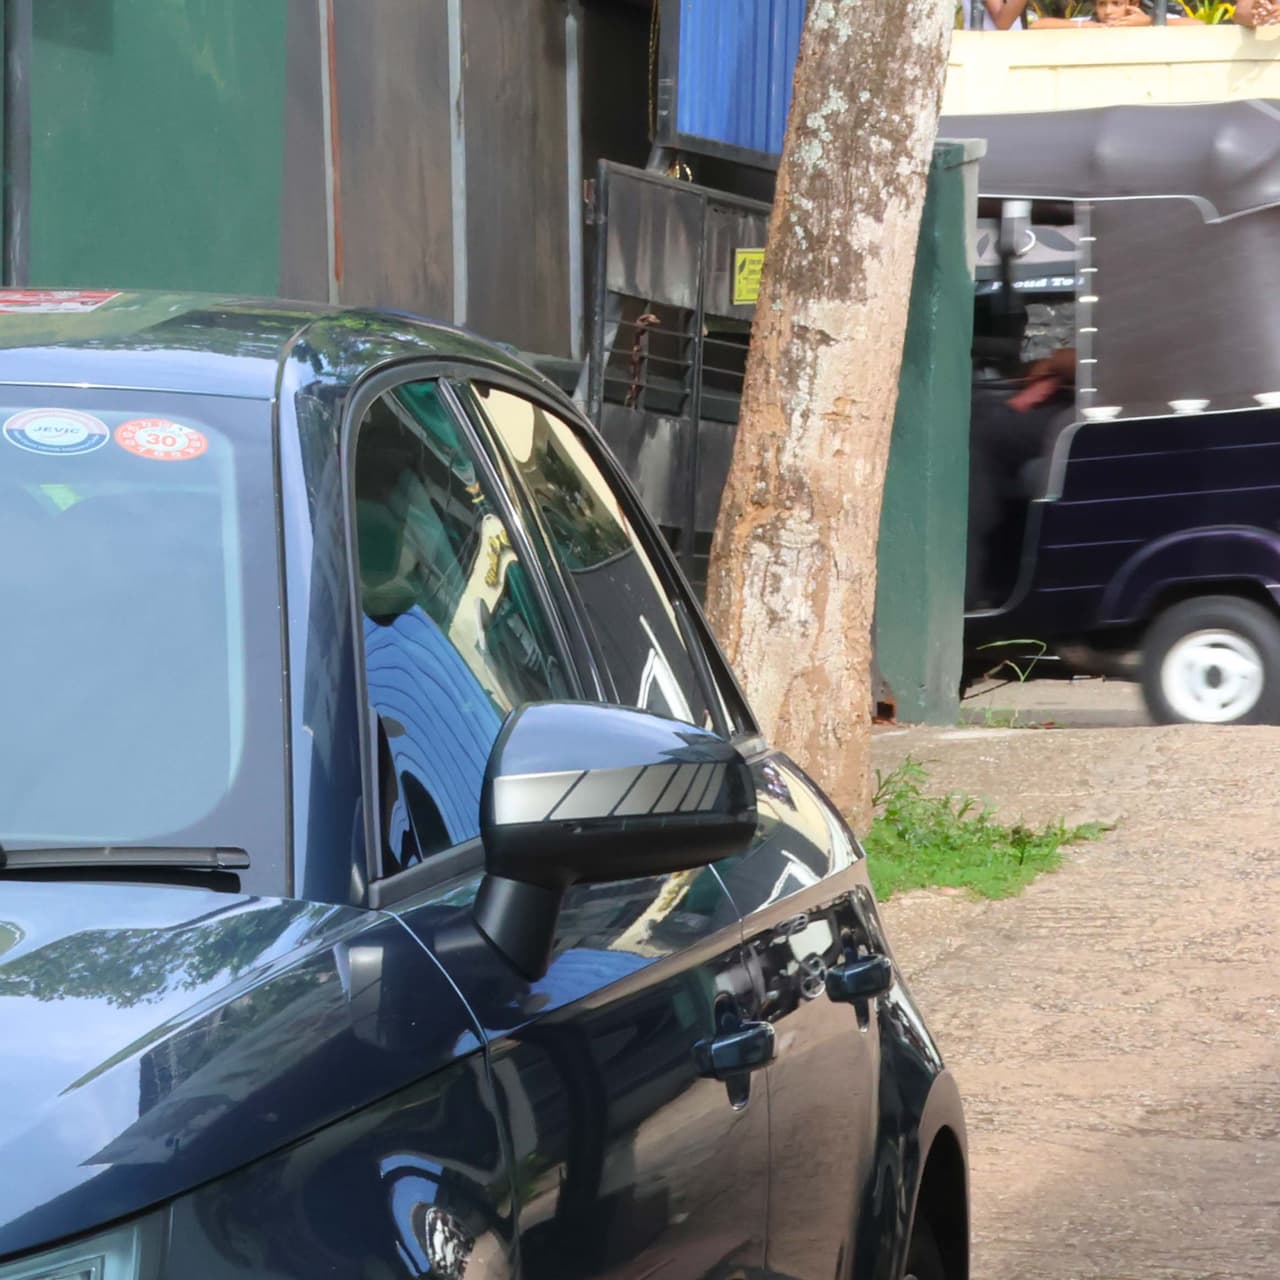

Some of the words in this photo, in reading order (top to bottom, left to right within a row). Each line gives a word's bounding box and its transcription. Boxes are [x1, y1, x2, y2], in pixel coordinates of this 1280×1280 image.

[991, 278, 1048, 290] Poud
[32, 425, 82, 435] JEVIC
[145, 433, 177, 447] 30
